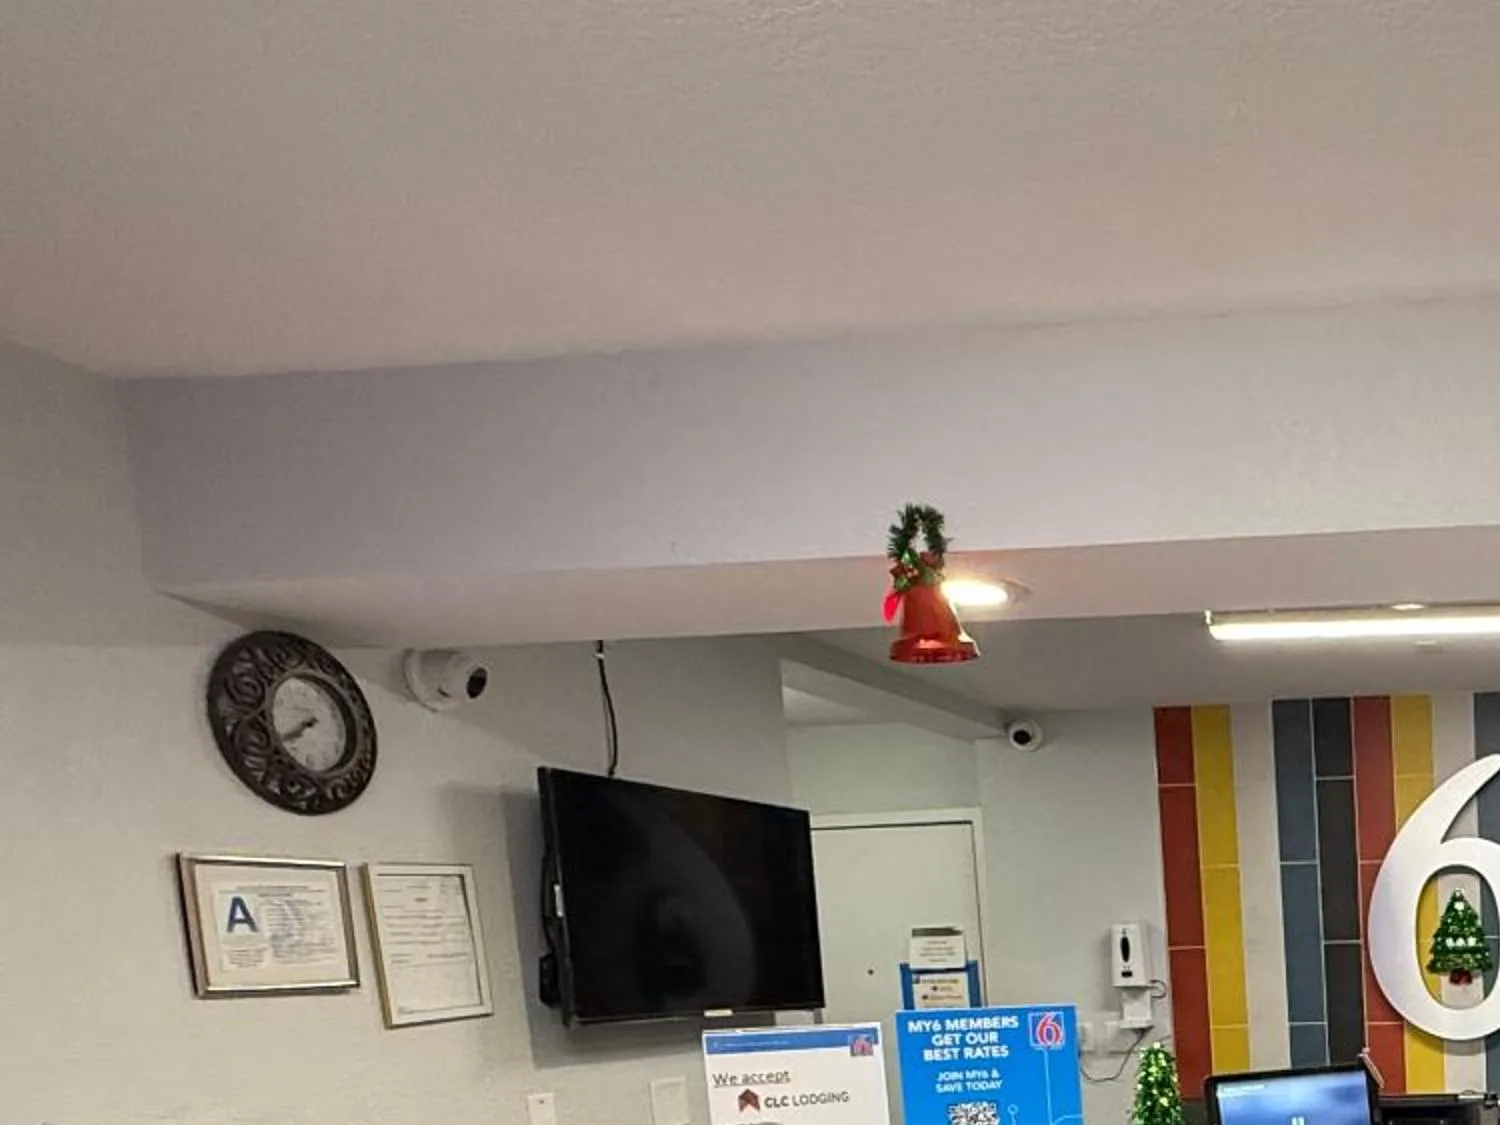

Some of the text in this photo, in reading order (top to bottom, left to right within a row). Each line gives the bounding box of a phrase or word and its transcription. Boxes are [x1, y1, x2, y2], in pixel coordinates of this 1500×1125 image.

[226, 896, 260, 933] A
[907, 1015, 1020, 1033] MY6 MEMBERS
[1034, 1012, 1065, 1046] 6
[931, 1031, 999, 1047] GET OUR
[923, 1045, 1010, 1062] BEST RATES
[712, 1070, 791, 1087] We accept
[936, 1071, 964, 1082] JOIN
[965, 1070, 987, 1080] MY6
[935, 1083, 963, 1093] SAVE
[763, 1091, 850, 1109] CLC LODGING
